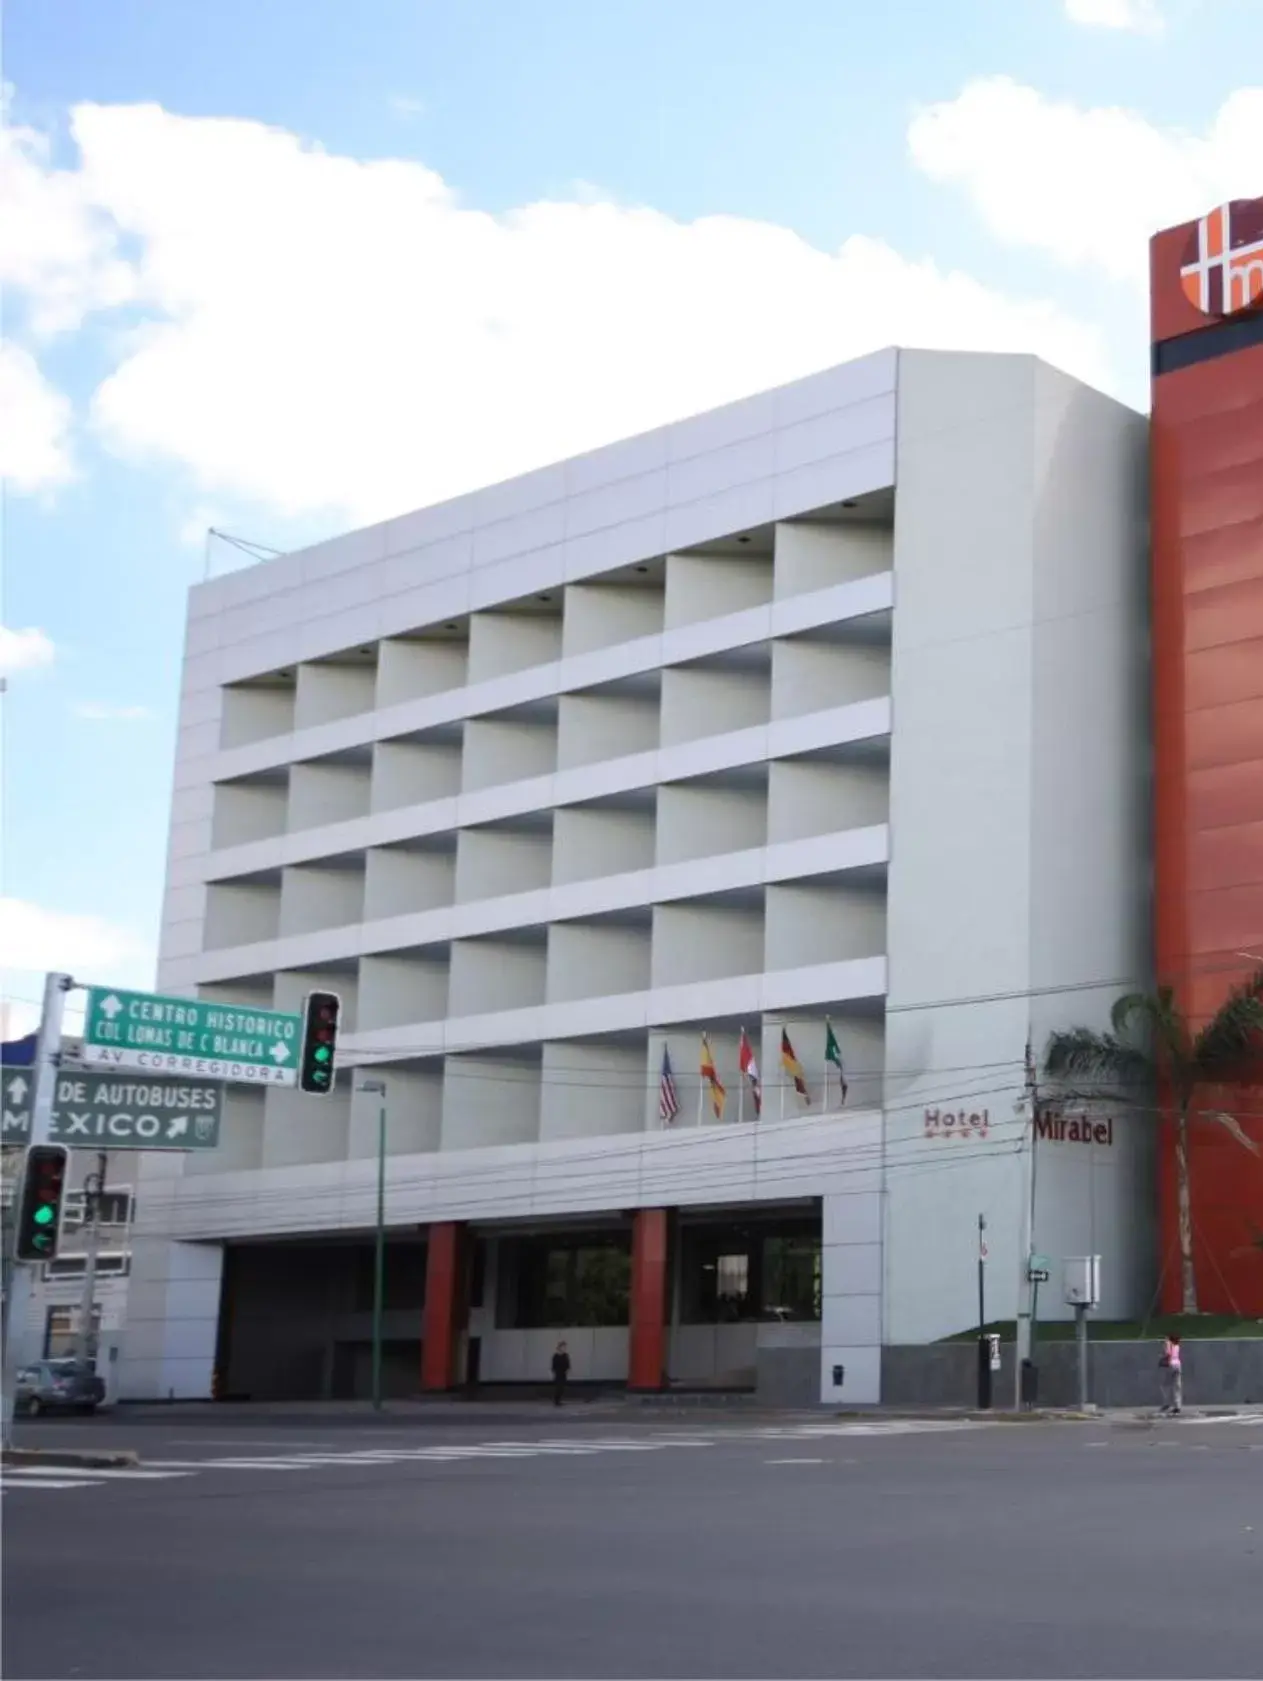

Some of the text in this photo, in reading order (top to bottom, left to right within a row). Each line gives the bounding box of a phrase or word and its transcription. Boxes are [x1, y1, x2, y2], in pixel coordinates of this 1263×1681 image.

[129, 1000, 295, 1039] CENTRO HISTORICO
[95, 1021, 264, 1057] COL LOMAS DE C BLANCA
[100, 1049, 285, 1081] AV CORREGIDORA
[58, 1081, 217, 1110] DE AUTOBUSES
[924, 1109, 989, 1128] Hotel
[1034, 1110, 1113, 1147] Mirabel
